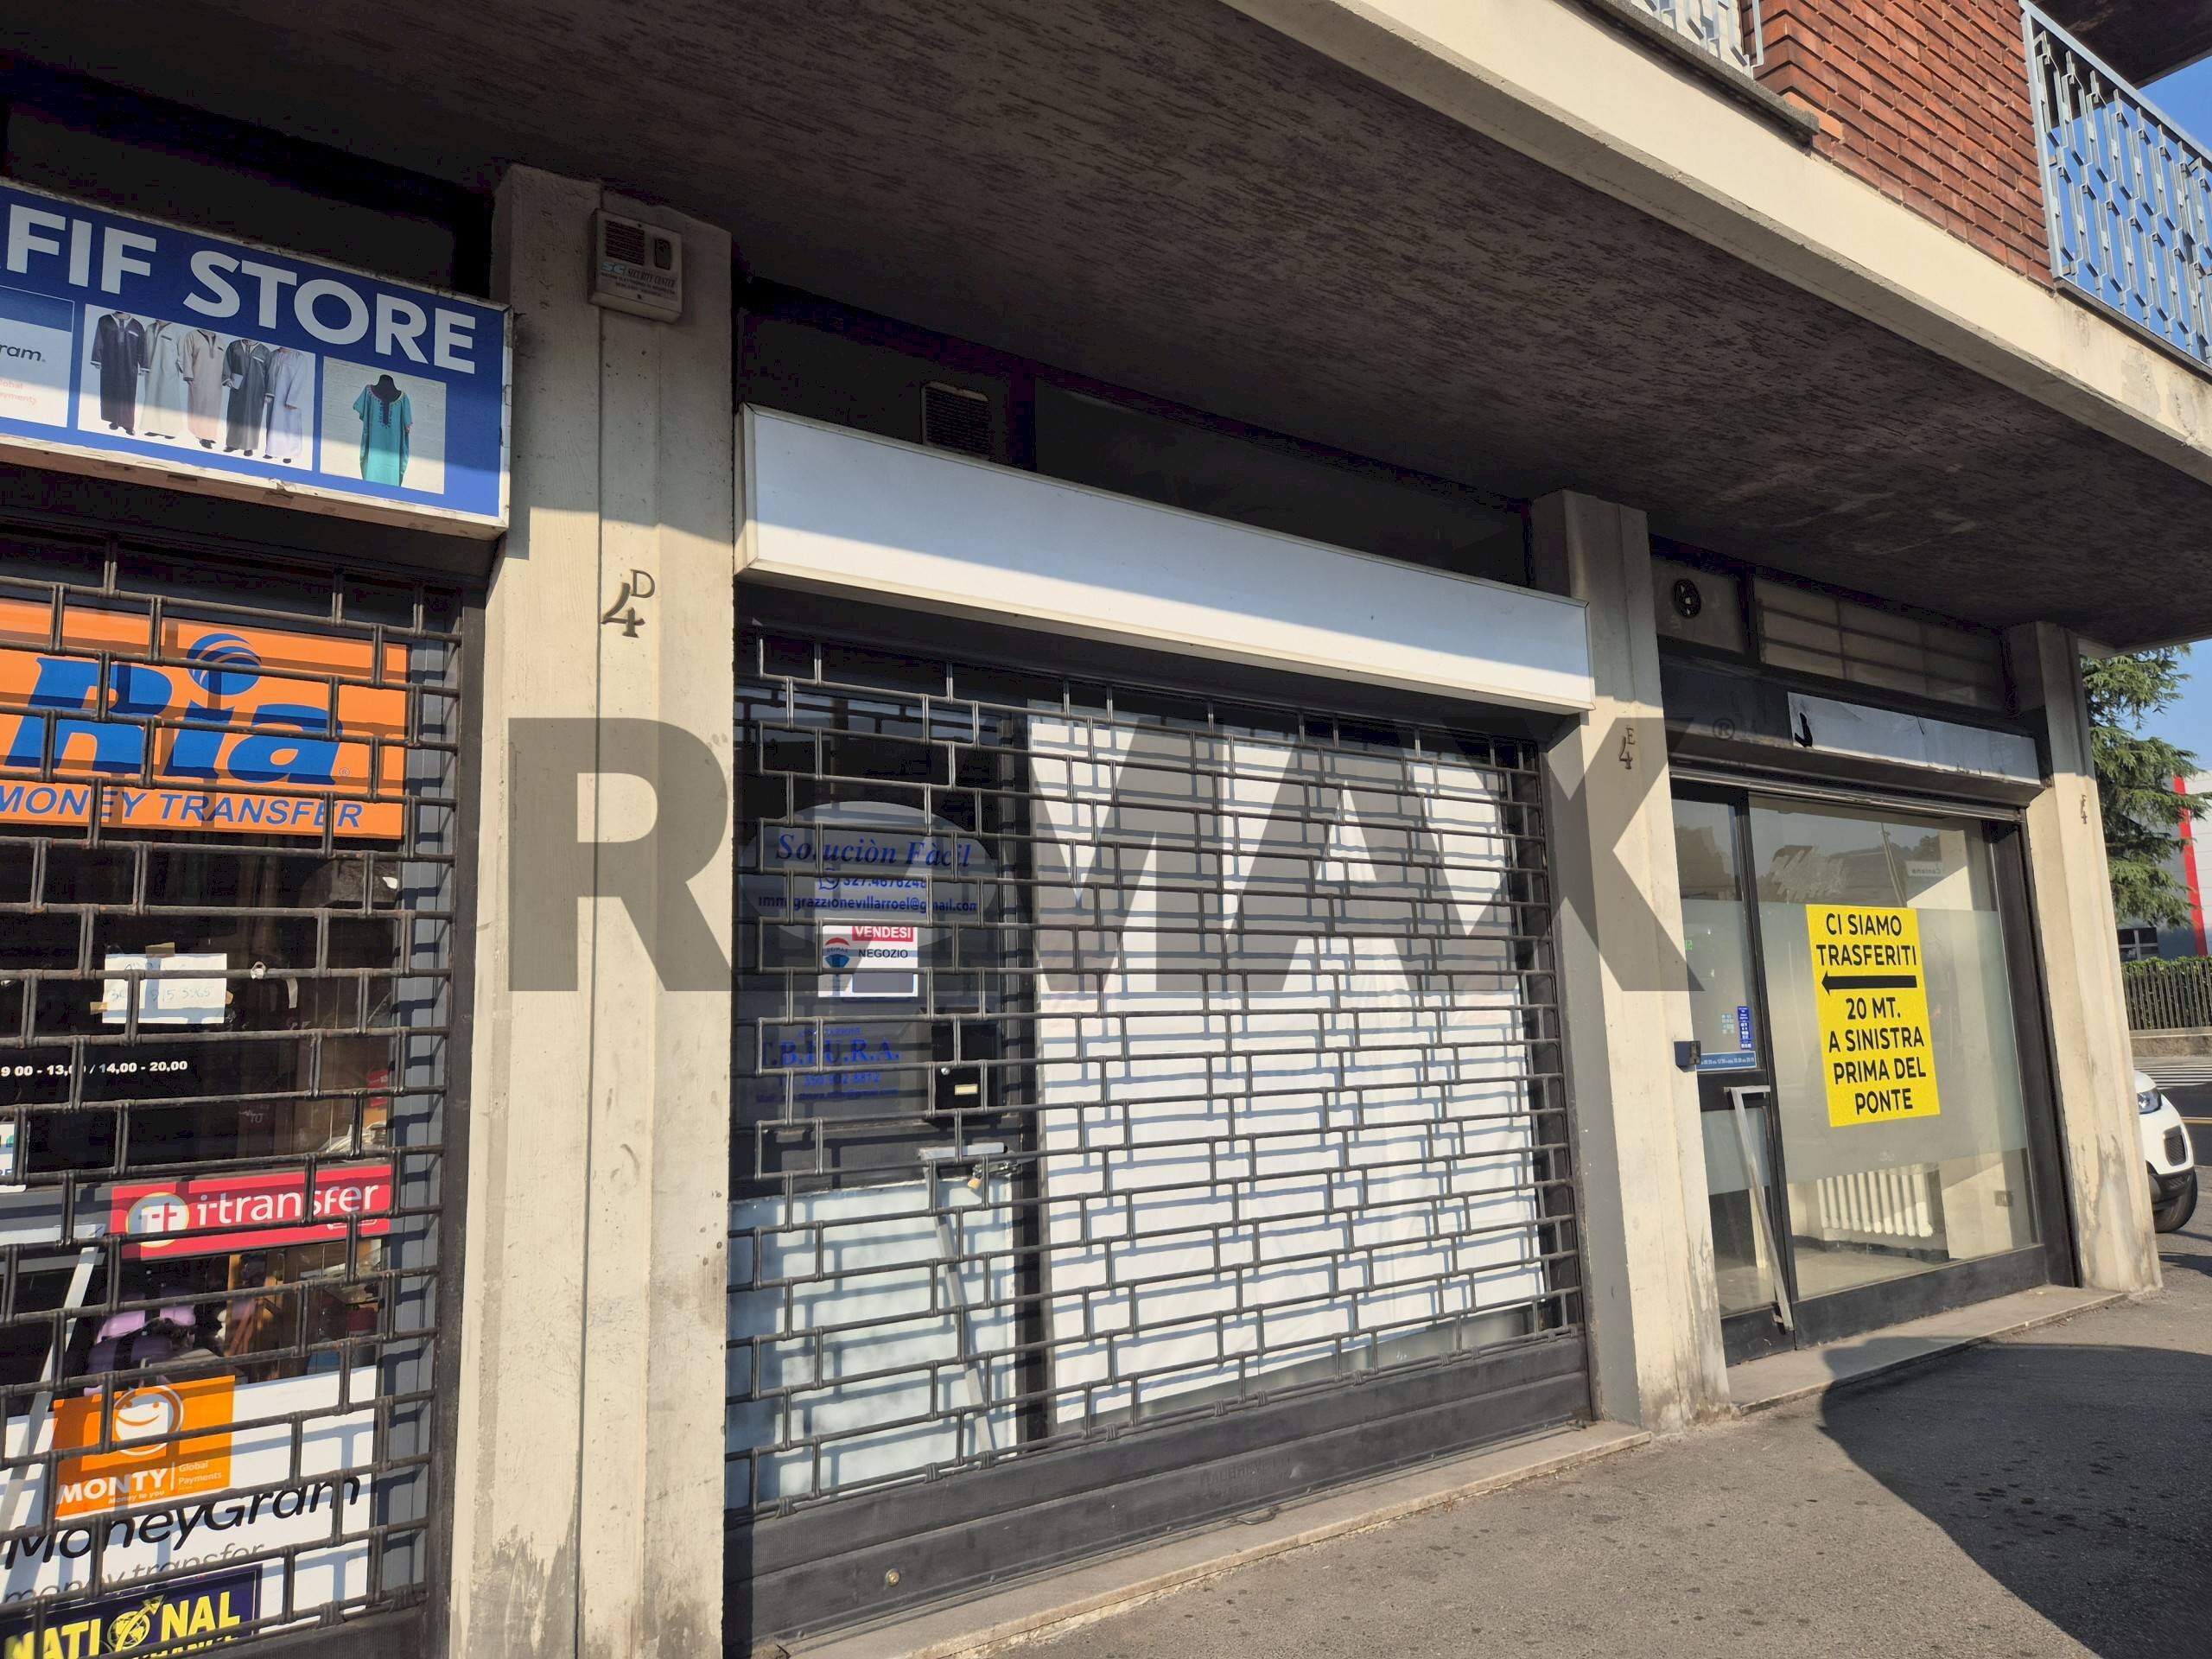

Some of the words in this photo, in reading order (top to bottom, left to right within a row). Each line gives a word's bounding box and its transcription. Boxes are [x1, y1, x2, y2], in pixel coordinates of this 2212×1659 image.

[183, 250, 476, 375] STORE
[3, 632, 344, 785] Ria
[0, 785, 147, 820] MONEY
[159, 792, 364, 830] TRANSFER
[854, 925, 912, 939] VENDESI
[1826, 912, 1842, 936] CI
[1847, 913, 1902, 937] SIAMO
[858, 949, 909, 958] NEGOZIO
[1815, 944, 1917, 966] TRASFERITI
[1846, 997, 1867, 1020] 20
[1872, 996, 1901, 1019] MT.
[1828, 1030, 1841, 1053] A
[1846, 1026, 1925, 1052] SINISTRA
[99, 1062, 137, 1075] 14,00
[149, 1060, 188, 1072] 20,00
[1833, 1058, 1891, 1085] PRIMA
[1894, 1056, 1927, 1080] DEL
[1854, 1088, 1914, 1116] PONTE
[178, 1459, 208, 1473] Global
[178, 1471, 222, 1486] Payments
[56, 1468, 169, 1505] MONTY
[149, 1489, 165, 1500] you
[3, 1476, 361, 1570] MoneyGram
